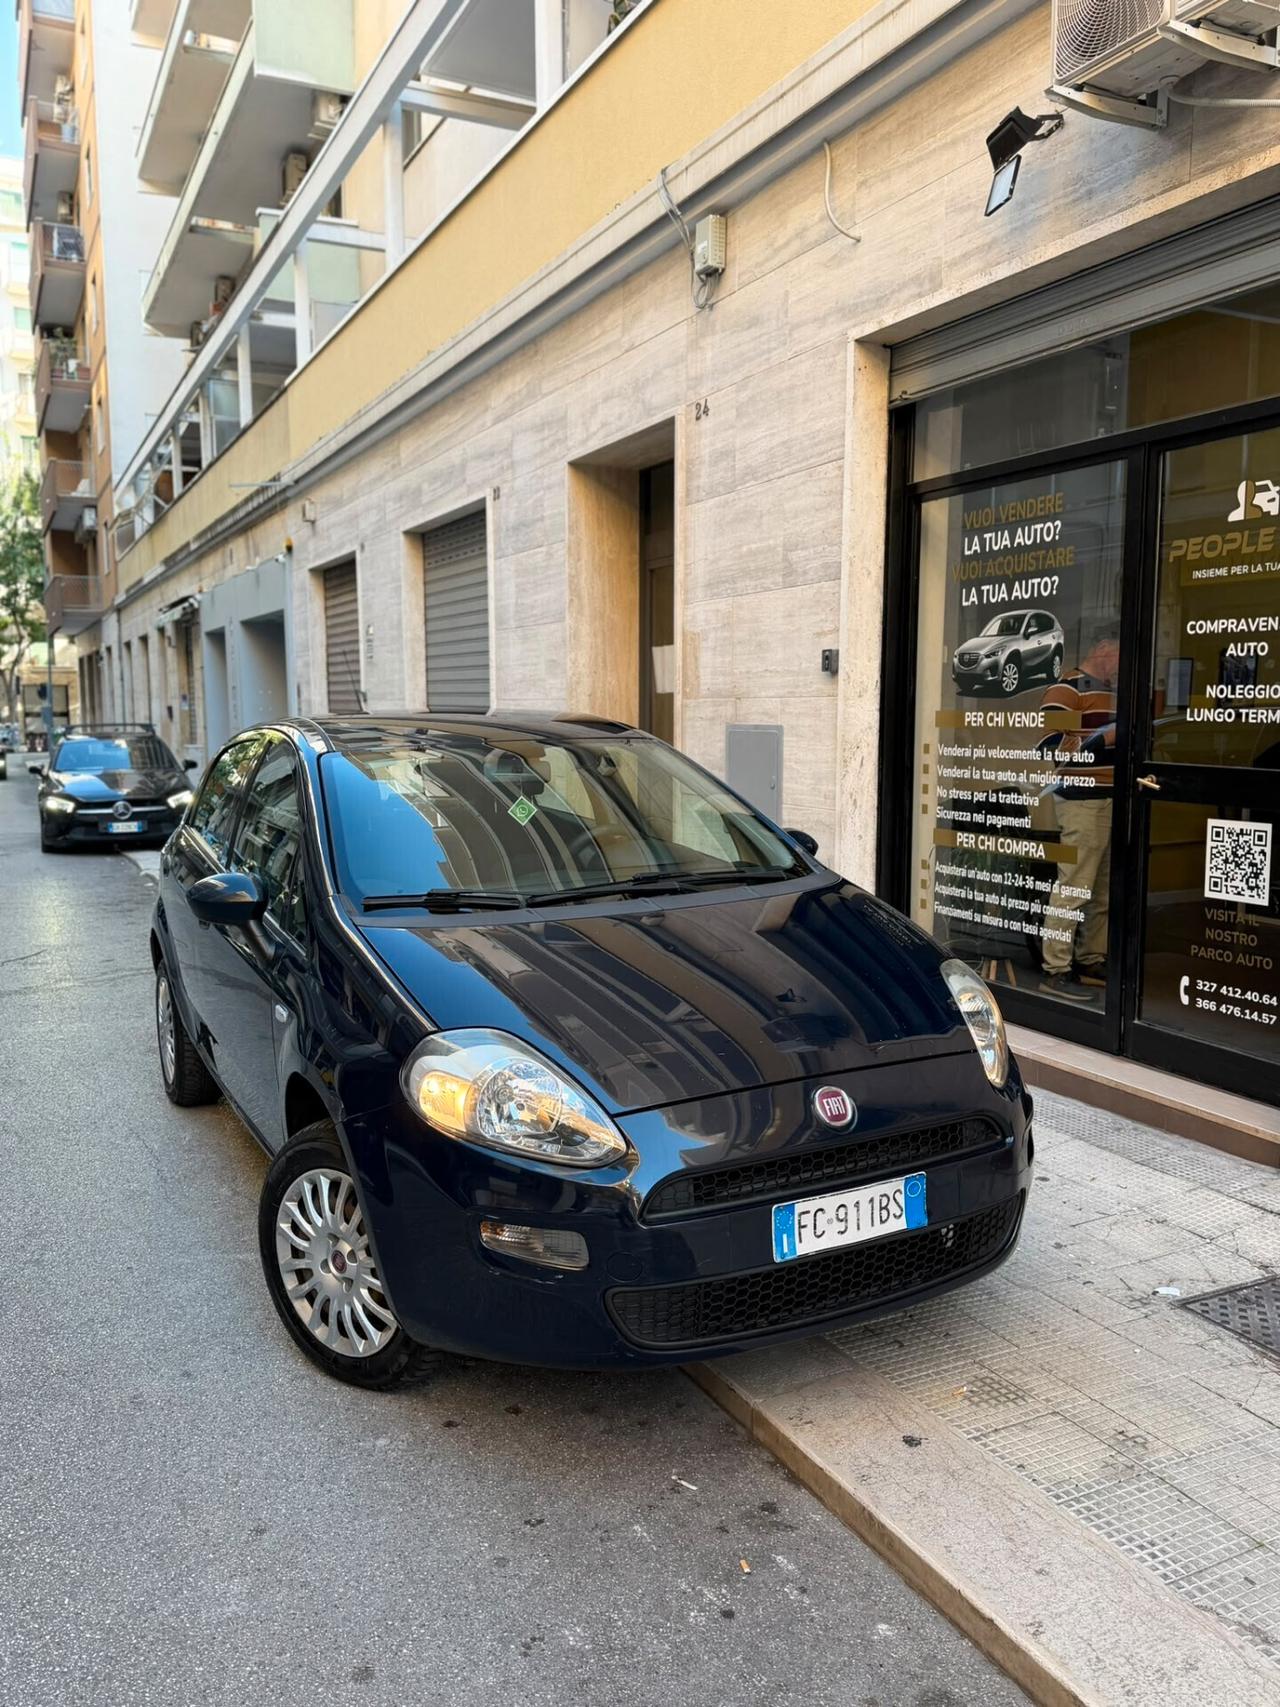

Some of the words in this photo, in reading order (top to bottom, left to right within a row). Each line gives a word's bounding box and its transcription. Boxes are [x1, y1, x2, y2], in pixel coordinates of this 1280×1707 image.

[696, 398, 710, 421] 24
[964, 508, 995, 529] VUOI
[1000, 492, 1064, 522] VENDERE
[964, 535, 980, 556] LA
[984, 530, 1010, 552] TUA
[1014, 520, 1062, 548] AUTO?
[1168, 527, 1276, 562] PEOPLE
[952, 561, 982, 583] VUOI
[985, 546, 1075, 578] ACQUISTARE
[1192, 567, 1228, 580] INSIEME
[1231, 564, 1249, 576] PER
[1251, 563, 1263, 574] LA
[962, 587, 978, 606] LA
[981, 583, 1008, 604] TUA
[1011, 576, 1060, 600] AUTO?
[1186, 616, 1279, 635] COMPRAVEN
[1226, 642, 1269, 657] AUTO
[1206, 684, 1280, 699] NOLEGGIO
[964, 712, 984, 727] PER
[986, 712, 1004, 727] CHI
[1007, 712, 1045, 728] VENDE
[1186, 708, 1236, 722] LUNGO
[1239, 708, 1280, 724] TERM
[938, 743, 972, 757] Venderai
[988, 745, 1042, 760] velocemente
[1044, 747, 1052, 760] la
[1054, 748, 1070, 762] tua
[1072, 750, 1095, 763] auto
[937, 764, 971, 778] Venderai
[972, 766, 980, 780] la
[982, 768, 996, 780] tua
[997, 769, 1016, 782] auto
[1018, 769, 1027, 782] al
[1030, 770, 1062, 787] miglior
[1063, 775, 1096, 788] prezzo
[936, 785, 948, 798] No
[948, 787, 972, 800] stress
[973, 790, 987, 804] per
[988, 790, 997, 803] la
[998, 792, 1040, 806] trattativa
[936, 806, 971, 822] Sicurezza
[973, 810, 986, 822] nei
[986, 814, 1032, 828] pagamenti
[956, 832, 976, 848] PER
[978, 835, 996, 851] CHI
[997, 838, 1046, 860] COMPRA
[934, 860, 967, 877] Acquisterai
[967, 867, 990, 882] un'auto
[991, 873, 1003, 884] con
[1004, 872, 1034, 890] 12-24-36
[1035, 878, 1052, 892] mesi
[1052, 880, 1060, 893] di
[1060, 885, 1092, 900] garanzia
[934, 881, 966, 898] Acquisterai
[967, 887, 973, 900] la
[974, 889, 984, 902] tua
[985, 892, 1000, 904] auto
[1001, 894, 1007, 906] al
[1008, 898, 1029, 911] prezzo
[1042, 905, 1085, 922] conveniente
[934, 901, 973, 921] Finanziamenti
[974, 912, 982, 922] su
[982, 912, 1003, 928] misura
[1004, 919, 1009, 928] o
[1010, 920, 1021, 932] con
[1022, 920, 1038, 935] tassi
[1039, 927, 1072, 942] agevolati
[1205, 907, 1245, 925] VISITA
[1249, 914, 1260, 927] IL
[1205, 928, 1258, 946] NOSTRO
[1190, 944, 1233, 962] PARCO
[1236, 953, 1273, 970] AUTO
[1196, 980, 1217, 992] 327
[1220, 985, 1278, 1006] 412.40.64
[1195, 998, 1217, 1011] 366
[1219, 1004, 1277, 1025] 476.14.57
[822, 1096, 846, 1117] FIAT
